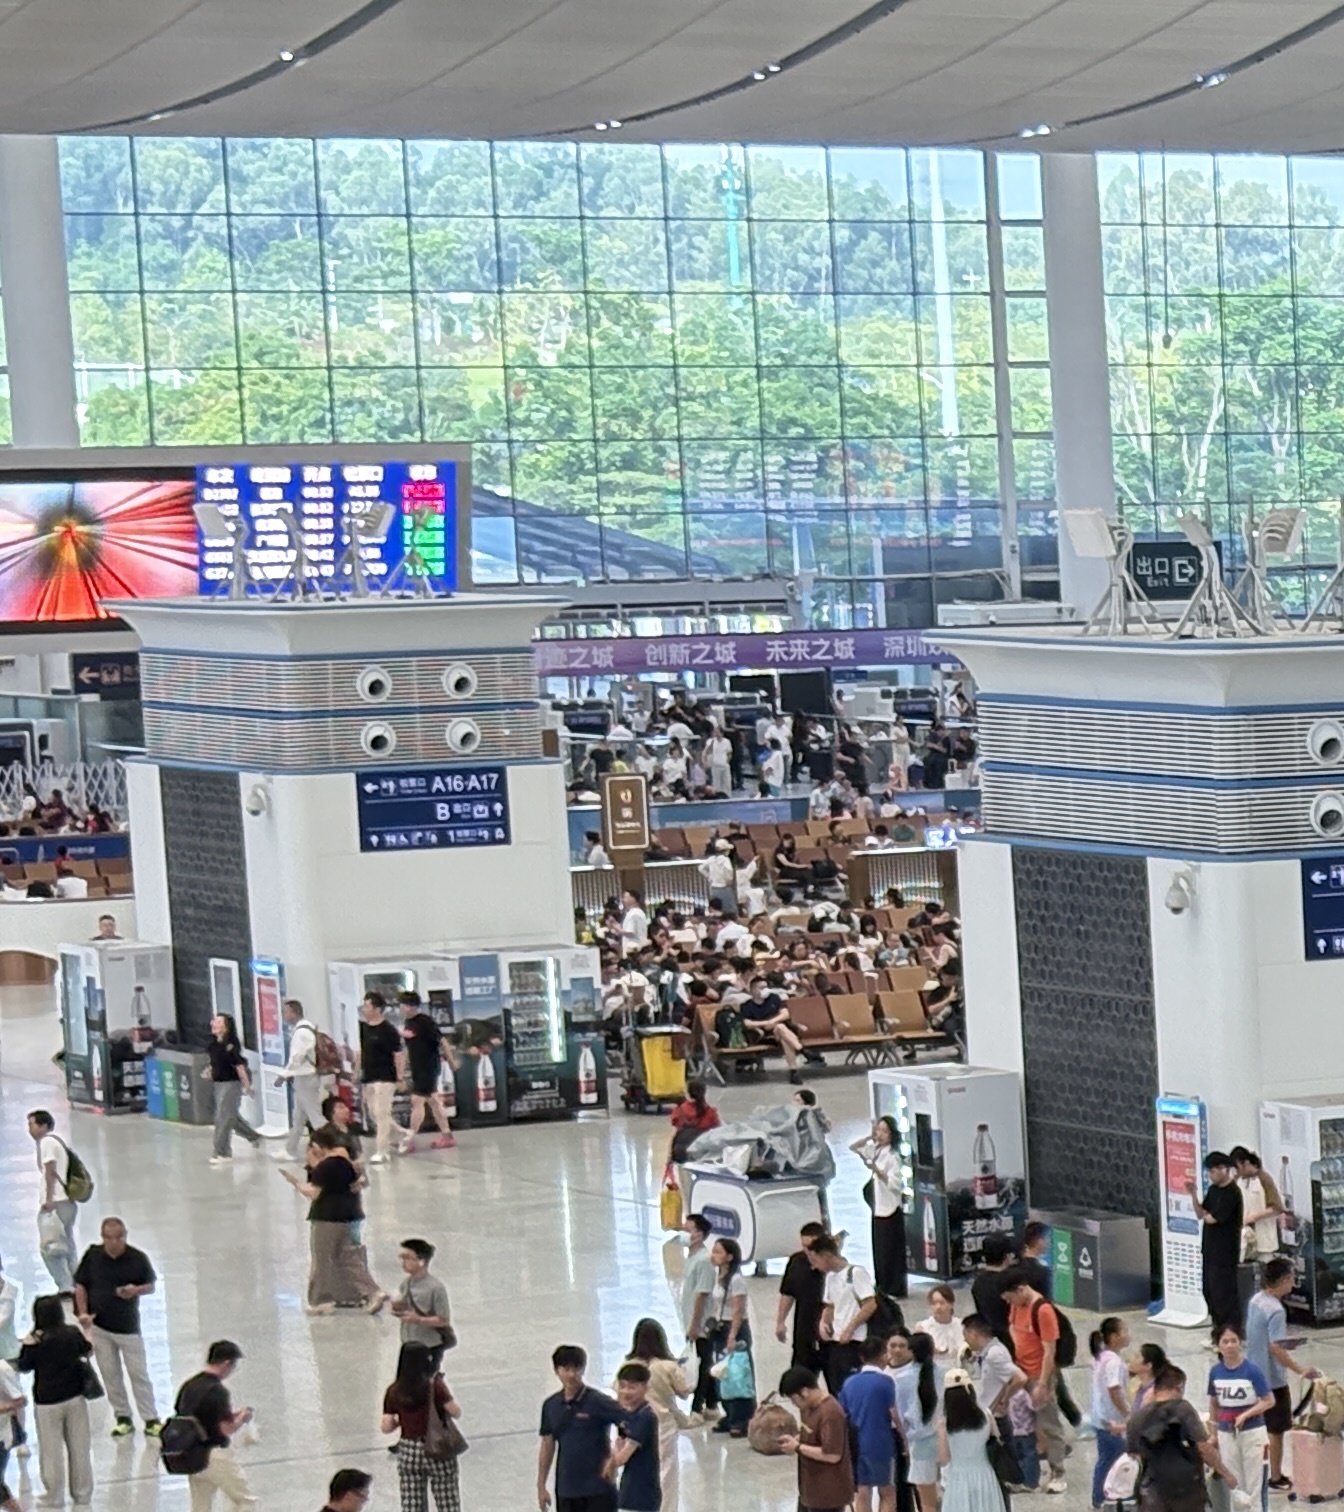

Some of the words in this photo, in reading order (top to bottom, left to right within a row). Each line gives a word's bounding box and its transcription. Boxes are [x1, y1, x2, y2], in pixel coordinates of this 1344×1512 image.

[1136, 555, 1170, 576] 出口
[644, 641, 737, 666] 创新之城
[765, 636, 855, 663] 未来之城
[436, 802, 450, 821] B
